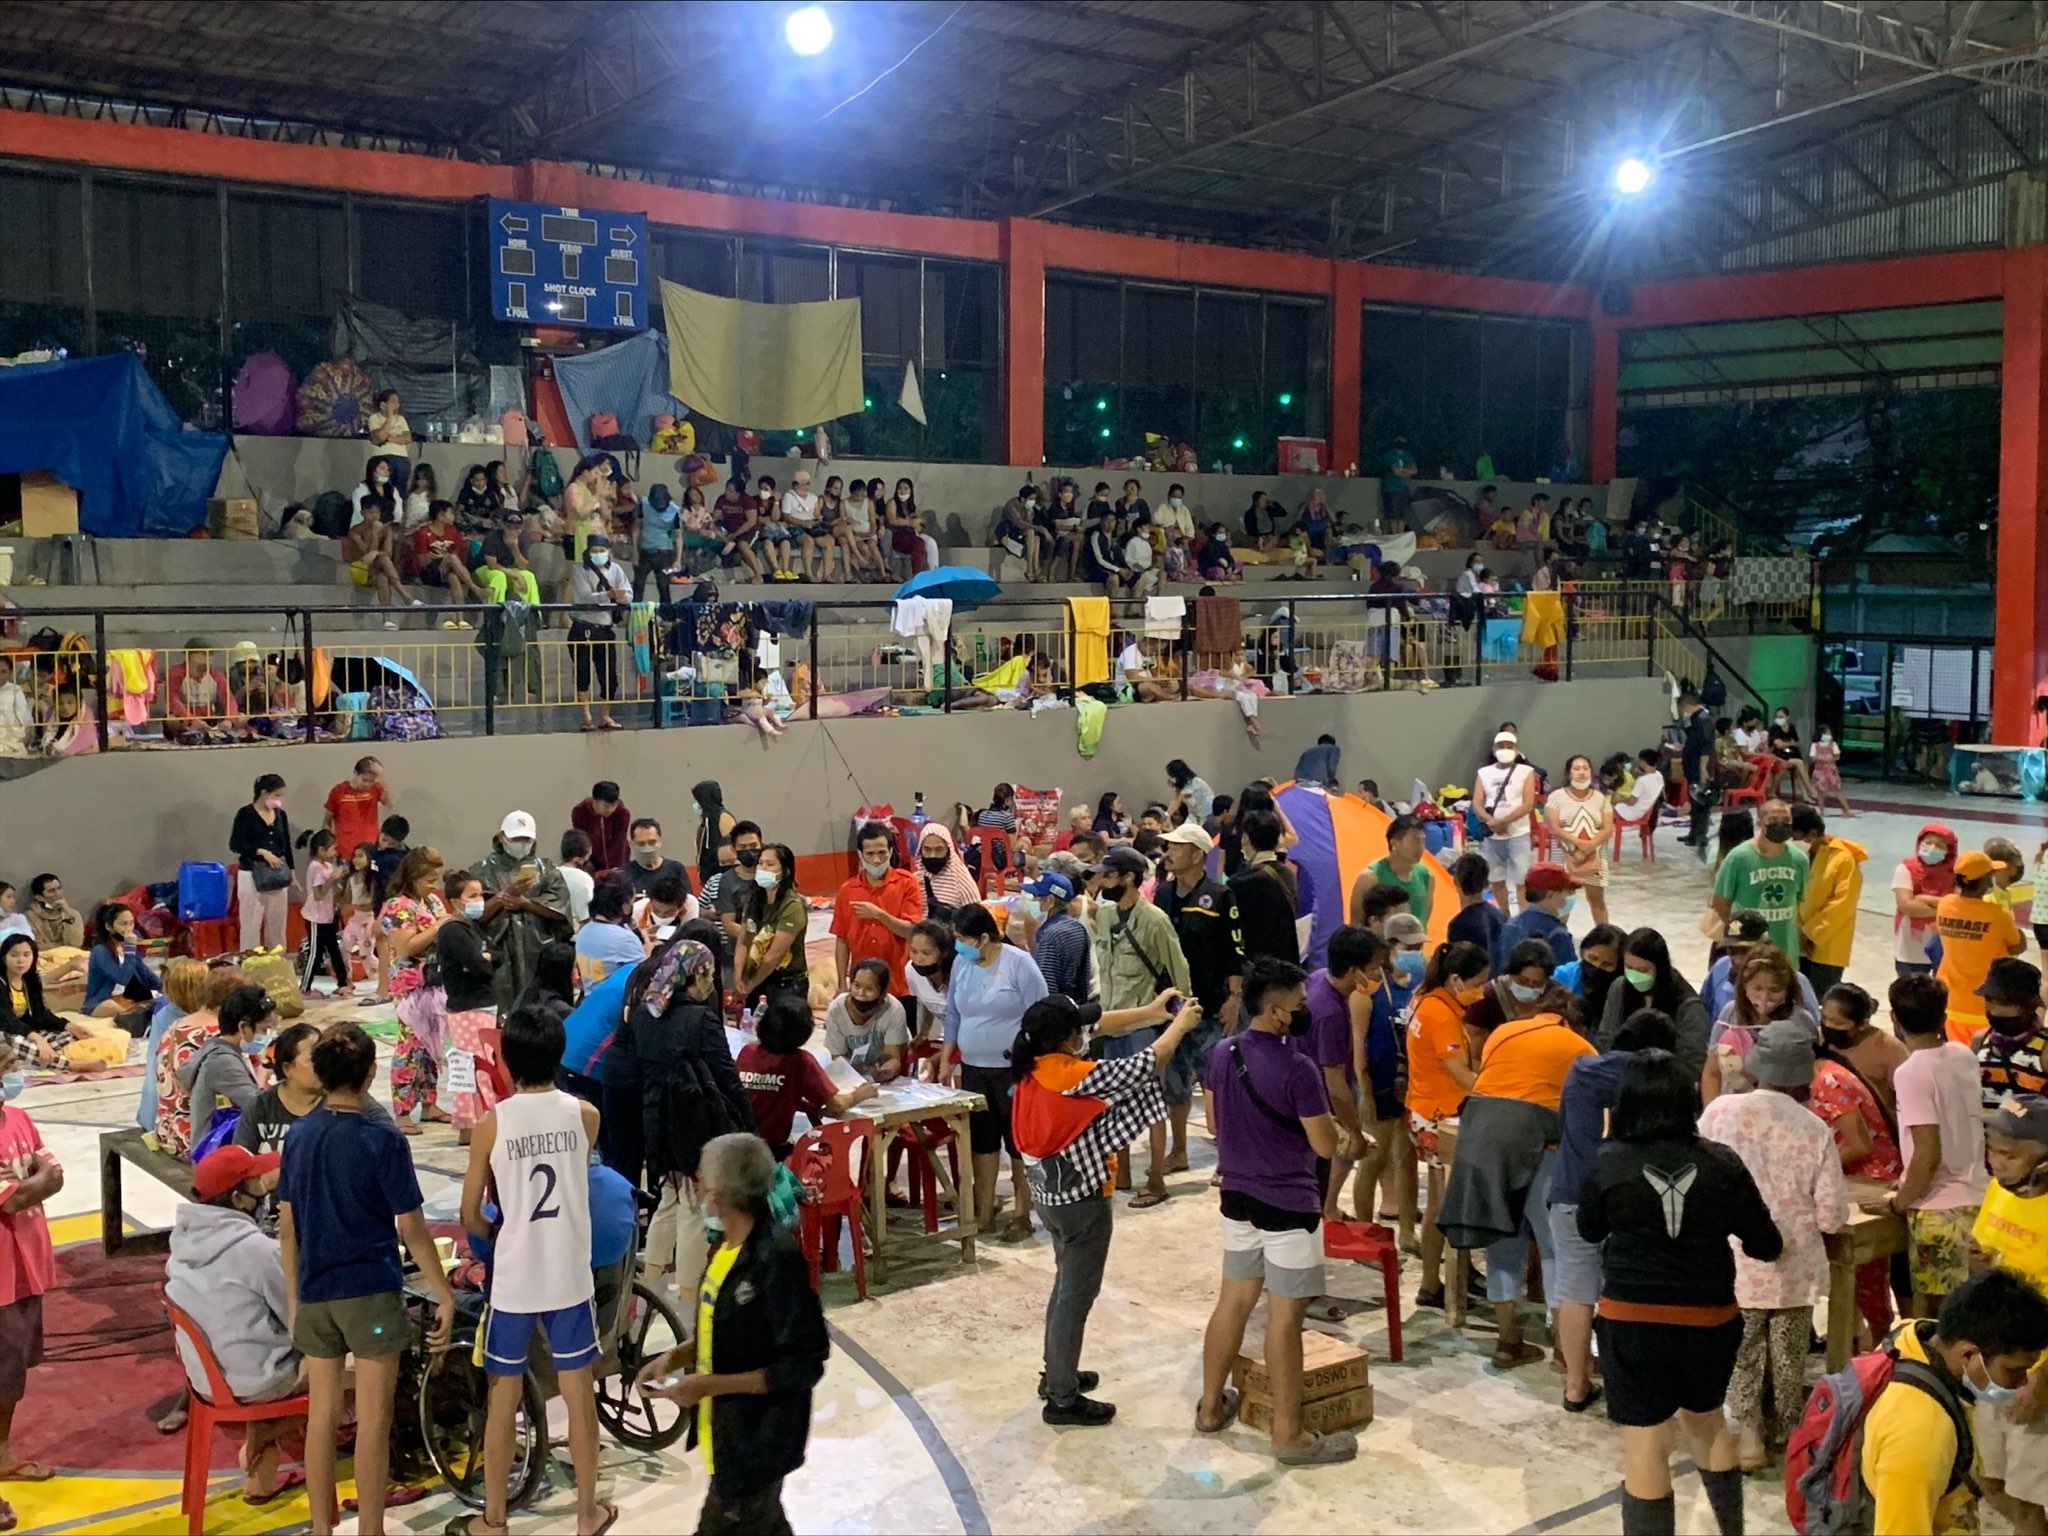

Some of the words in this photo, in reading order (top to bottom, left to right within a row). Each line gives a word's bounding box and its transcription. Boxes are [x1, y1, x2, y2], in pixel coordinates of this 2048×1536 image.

[560, 207, 579, 217] TIME
[508, 239, 527, 248] HOME
[559, 244, 582, 254] PERIOD
[611, 249, 633, 259] GUEST
[544, 283, 566, 294] SHOT
[569, 285, 597, 297] CLOCK
[512, 309, 530, 319] FOUL
[619, 317, 635, 327] FOUL
[1749, 866, 1797, 886] LUCKY
[1754, 906, 1794, 923] HIRT
[506, 1129, 578, 1161] PABERECIO
[528, 1163, 561, 1223] 2
[1315, 1366, 1348, 1387] DSWD
[1321, 1399, 1353, 1419] DSWD
